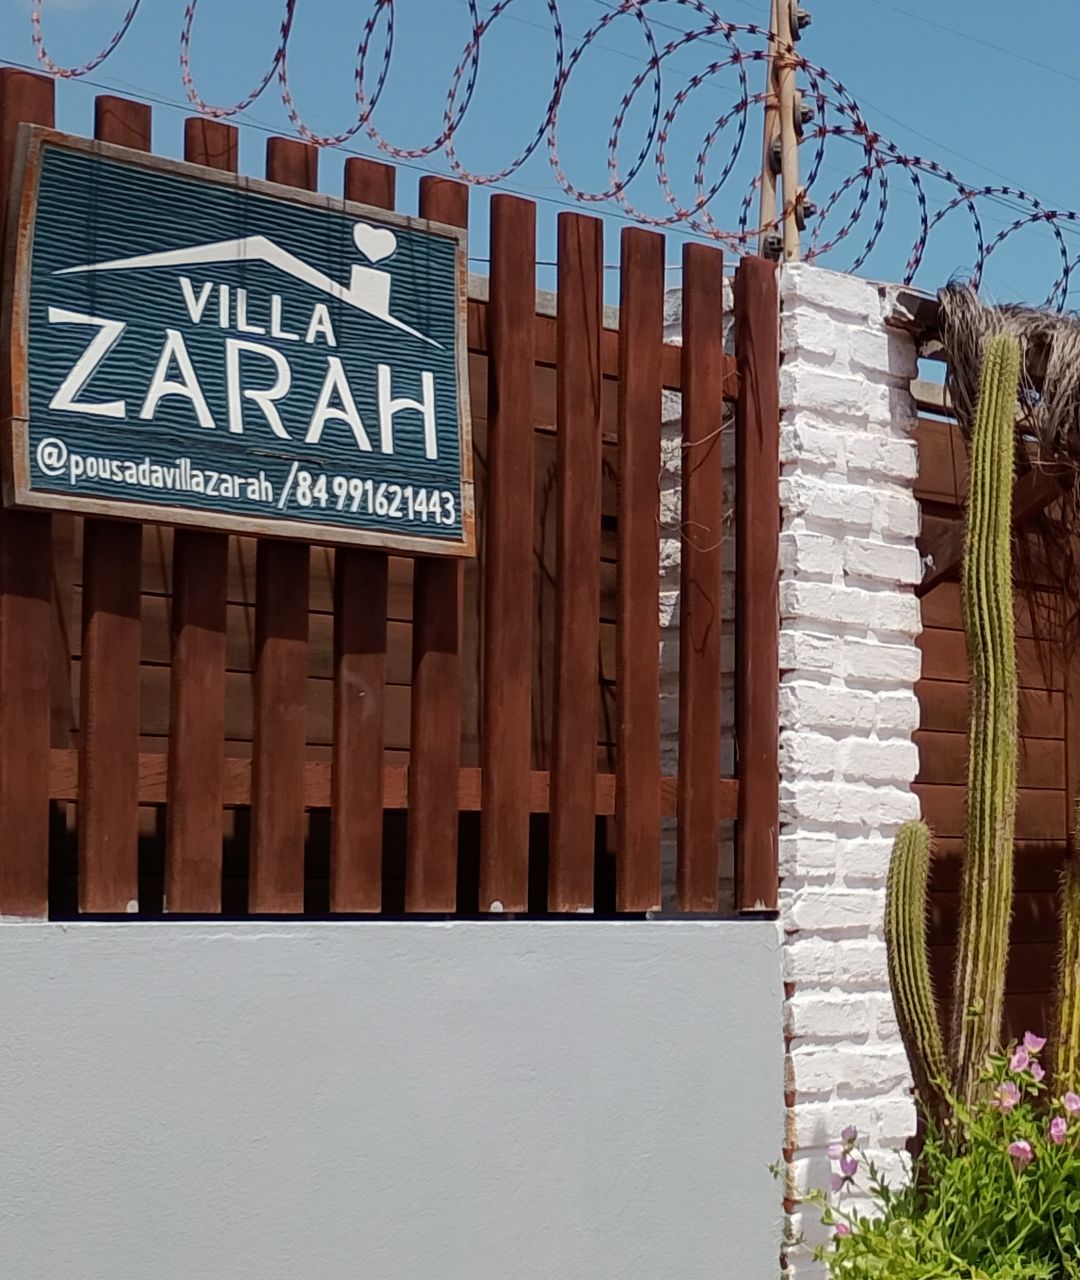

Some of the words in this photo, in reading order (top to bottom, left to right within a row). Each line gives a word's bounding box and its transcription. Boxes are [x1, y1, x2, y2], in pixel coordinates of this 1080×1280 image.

[178, 276, 337, 346] VILLA
[47, 306, 438, 460] ZARAH
[36, 437, 274, 503] @pousadavillazarah
